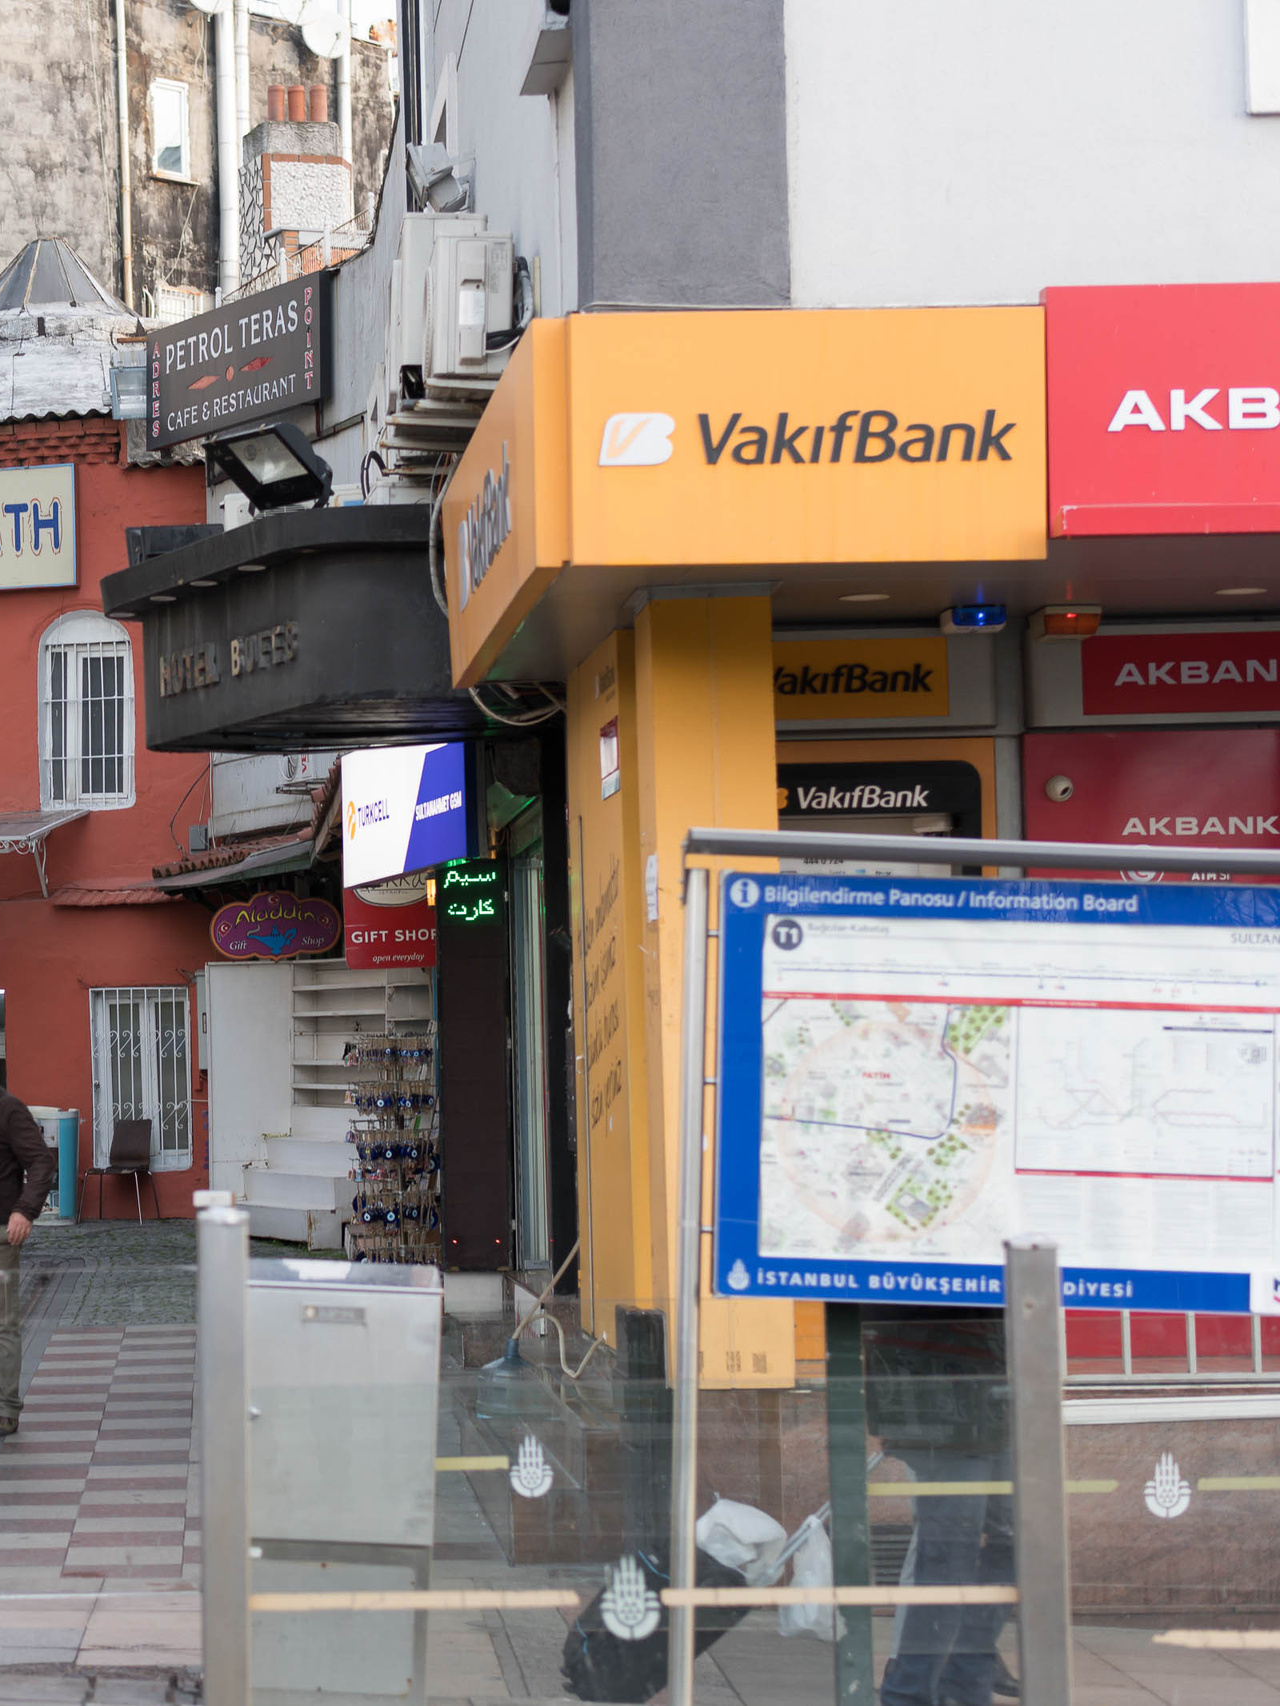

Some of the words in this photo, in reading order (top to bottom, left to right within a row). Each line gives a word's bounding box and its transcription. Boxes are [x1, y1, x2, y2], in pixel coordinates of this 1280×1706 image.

[165, 324, 233, 374] PETROL
[238, 300, 298, 348] TERAS
[152, 342, 160, 437] ADRES
[167, 405, 198, 431] CAFE
[202, 403, 210, 420] &
[213, 374, 296, 417] RESTAURANT
[1107, 387, 1280, 431] AKB
[697, 409, 1017, 466] VakıfBank
[1114, 659, 1278, 687] AKBAN
[450, 790, 462, 810] GSM
[796, 785, 930, 809] VakıfBank
[357, 798, 390, 828] TURKCELL
[1121, 816, 1280, 836] AKBANK
[764, 886, 885, 909] Bilgilendirme
[889, 890, 954, 908] Panosu
[957, 891, 967, 908] /
[970, 891, 1078, 911] Information
[1083, 894, 1139, 912] Board
[235, 903, 316, 928] Aladdin
[229, 940, 247, 951] Gift
[301, 936, 325, 947] Shop
[351, 930, 389, 944] GIFT
[776, 926, 799, 944] T1
[372, 953, 391, 964] open
[392, 952, 425, 962] everyday
[756, 1267, 860, 1289] İSTANBUL
[867, 1272, 1002, 1295] BÜYÜKŞEHİR
[1062, 1278, 1134, 1298] DİYESİ
